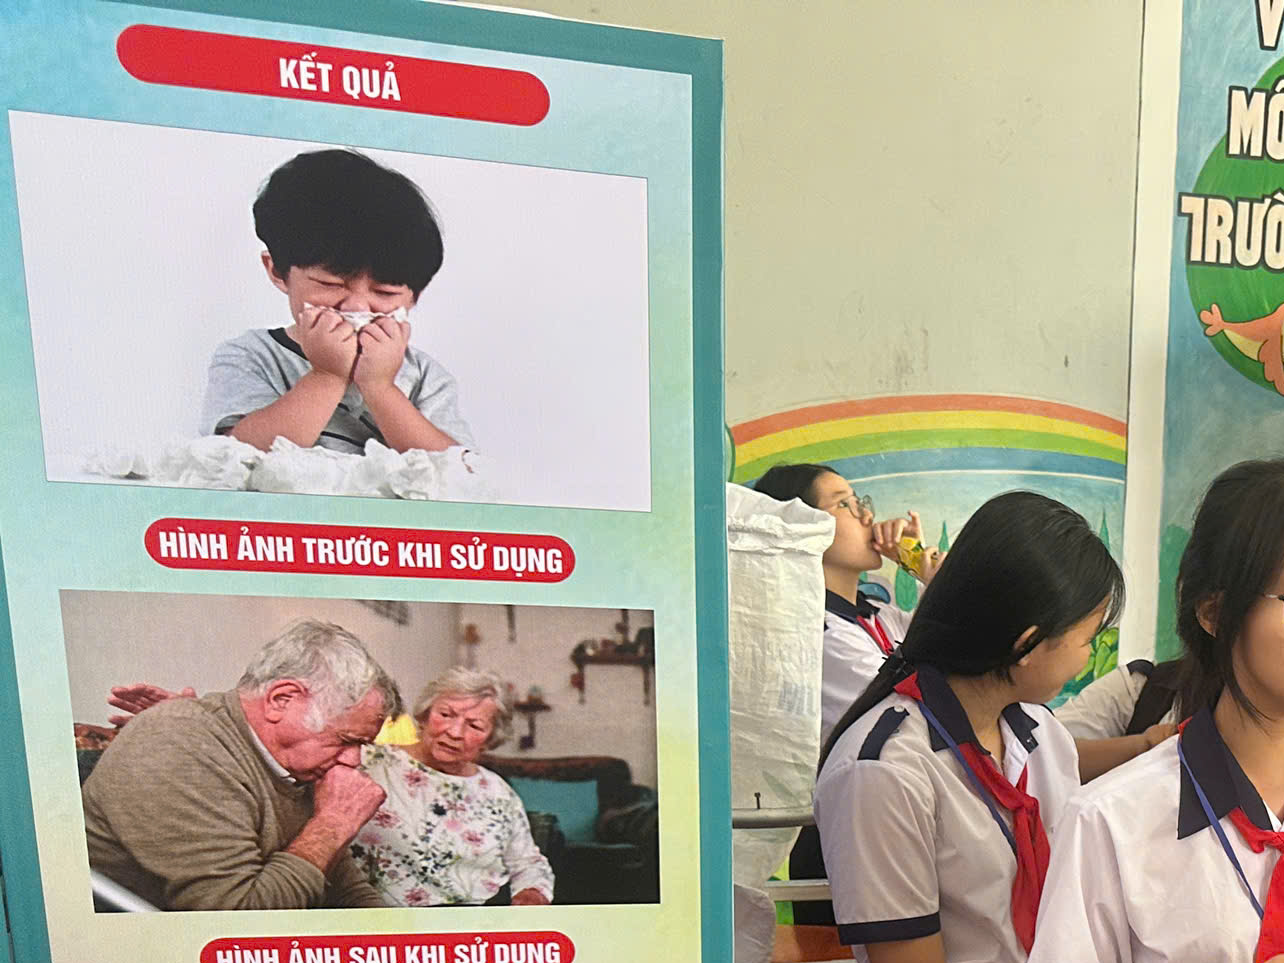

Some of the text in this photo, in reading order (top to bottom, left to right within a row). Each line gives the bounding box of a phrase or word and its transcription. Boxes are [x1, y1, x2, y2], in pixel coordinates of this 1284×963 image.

[279, 52, 401, 102] KẾT QUẢ
[158, 525, 563, 578] HÌNH ẢNH TRƯỚC KHI SỬ DỤNG
